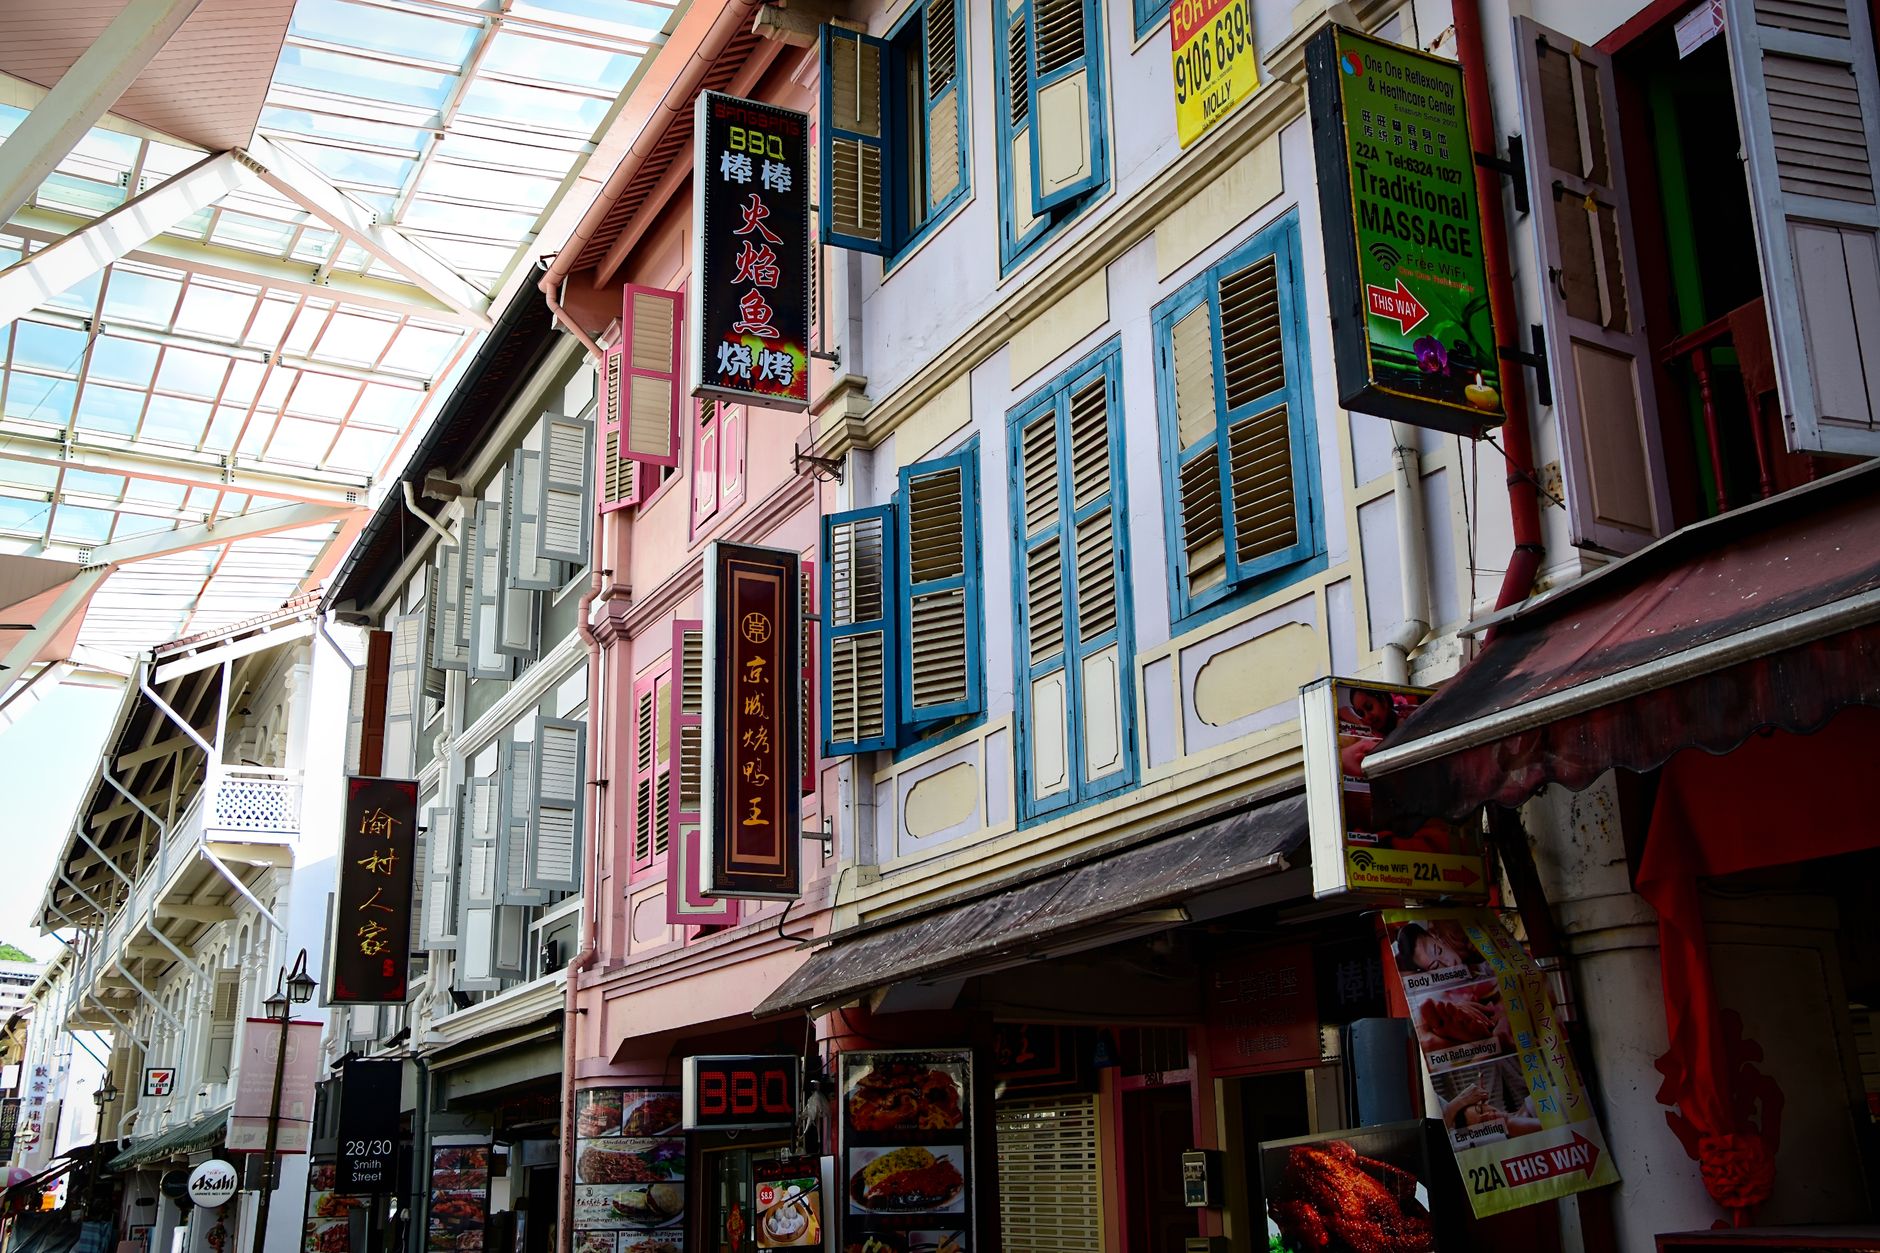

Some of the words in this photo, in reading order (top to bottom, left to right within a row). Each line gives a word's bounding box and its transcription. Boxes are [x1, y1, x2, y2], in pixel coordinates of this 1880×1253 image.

[1173, 0, 1204, 40] FOR
[1176, 32, 1212, 104] 9106
[1364, 54, 1383, 74] One
[1384, 61, 1402, 80] One
[1405, 67, 1454, 99] Reflexology
[1203, 79, 1231, 119] MOLLY
[1368, 76, 1376, 93] &
[1379, 80, 1426, 108] Healthcare
[1428, 95, 1456, 116] Center
[729, 126, 786, 161] BBQ
[720, 150, 793, 193] 棒棒
[1356, 141, 1380, 163] 22A
[1386, 150, 1433, 178] Tel:6324
[1436, 166, 1462, 186] 1027
[1355, 162, 1469, 221] Traditional
[1360, 199, 1473, 258] MASSAGE
[1406, 254, 1434, 272] Free
[1372, 293, 1394, 313] THIS
[1395, 299, 1417, 318] WAY
[717, 340, 794, 386] 烧烤
[743, 655, 770, 826] 京城烤鸭王
[1353, 872, 1365, 881] One
[1366, 873, 1379, 882] One
[1380, 874, 1413, 886] Reflexology
[1371, 862, 1389, 872] Free
[1390, 863, 1408, 873] WiFi
[1413, 862, 1441, 881] 22A
[1407, 973, 1429, 989] Body
[1430, 967, 1468, 984] Massage
[1430, 1052, 1448, 1065] Foot
[1449, 1041, 1498, 1062] Reflexology
[152, 1072, 169, 1095] 7
[700, 1072, 793, 1114] BBQ
[1454, 1130, 1468, 1143] Ear
[1468, 1122, 1505, 1140] Candling
[346, 1140, 392, 1157] 28/30
[1506, 1157, 1550, 1181] THIS
[1550, 1143, 1592, 1170] WAY
[352, 1172, 382, 1182] Street
[353, 1159, 382, 1170] Smith
[1468, 1164, 1506, 1194] 22A
[192, 1174, 235, 1190] Asahi
[759, 1191, 773, 1200] $8.8
